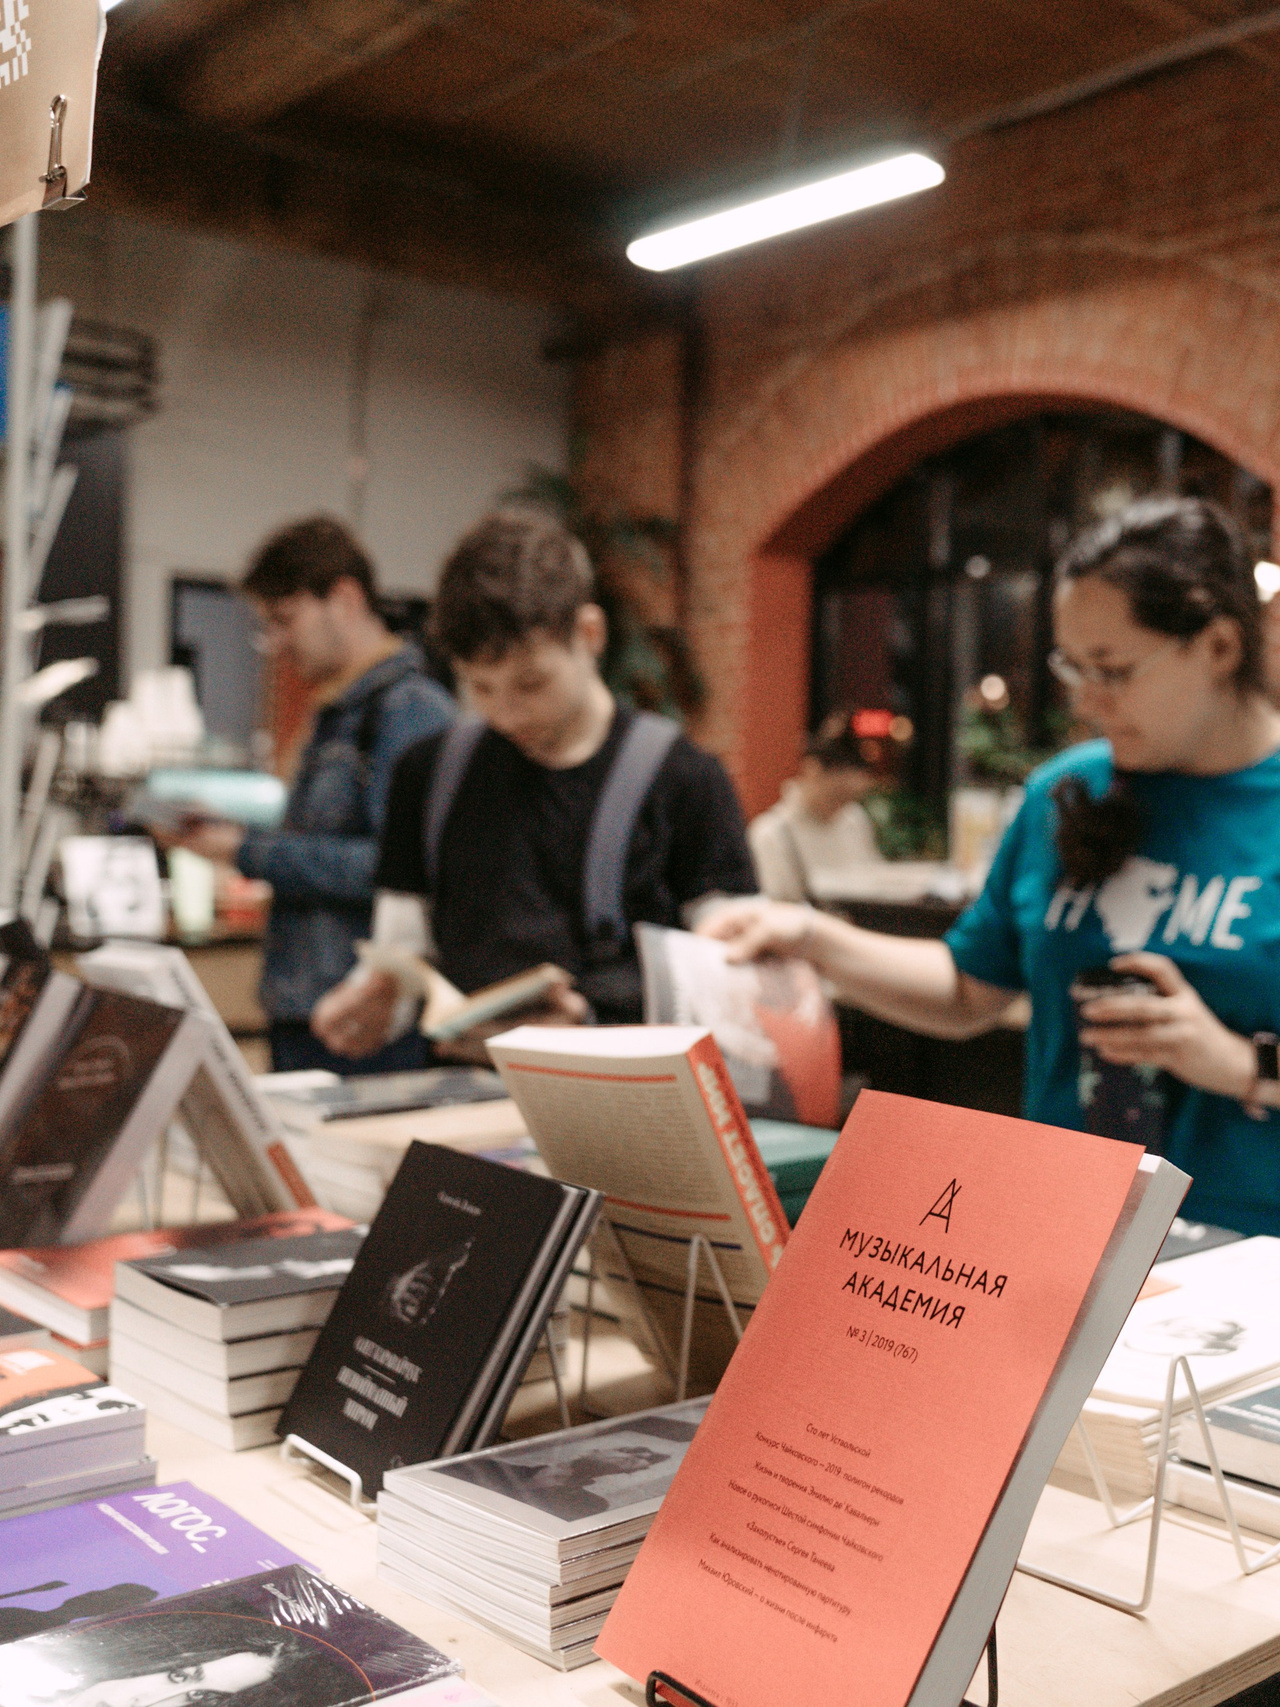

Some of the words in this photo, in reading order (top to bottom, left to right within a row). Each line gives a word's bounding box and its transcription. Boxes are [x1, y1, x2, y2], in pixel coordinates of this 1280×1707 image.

[697, 1061, 732, 1127] МИР
[722, 1130, 776, 1244] СПАСЕТ
[839, 1228, 1008, 1298] МУЗЫКАЛЬНАЯ
[841, 1271, 966, 1329] АКАДЕМИЯ
[846, 1326, 859, 1339] №
[859, 1331, 867, 1342] 3
[871, 1334, 895, 1352] 2019
[893, 1345, 919, 1363] (767)
[755, 1431, 780, 1450] Конкурс
[780, 1443, 819, 1467] Чайковского
[842, 1473, 871, 1491] полигон
[870, 1484, 904, 1505] рекордов
[806, 1422, 818, 1435] Сто
[816, 1428, 829, 1440] лет
[829, 1432, 871, 1458] Уствольской
[728, 1480, 747, 1495] Новое
[751, 1493, 781, 1513] рукописи
[780, 1505, 807, 1524] Шестой
[806, 1519, 841, 1541] симфонии
[841, 1536, 884, 1562] Чайковского
[753, 1461, 773, 1477] Жизнь
[778, 1474, 808, 1493] творения
[807, 1486, 834, 1505] Эмилио
[844, 1504, 880, 1527] Кавальери
[709, 1532, 720, 1545] Как
[720, 1541, 763, 1569] анализировать
[763, 1564, 817, 1597] ненотированную
[816, 1591, 852, 1616] партитуру
[786, 1541, 809, 1558] Сергея
[809, 1552, 835, 1572] Танеева
[698, 1558, 721, 1578] Михаил
[721, 1572, 754, 1596] Юровский
[764, 1599, 786, 1614] жизни
[785, 1609, 806, 1626] после
[805, 1620, 838, 1643] инфаркта
